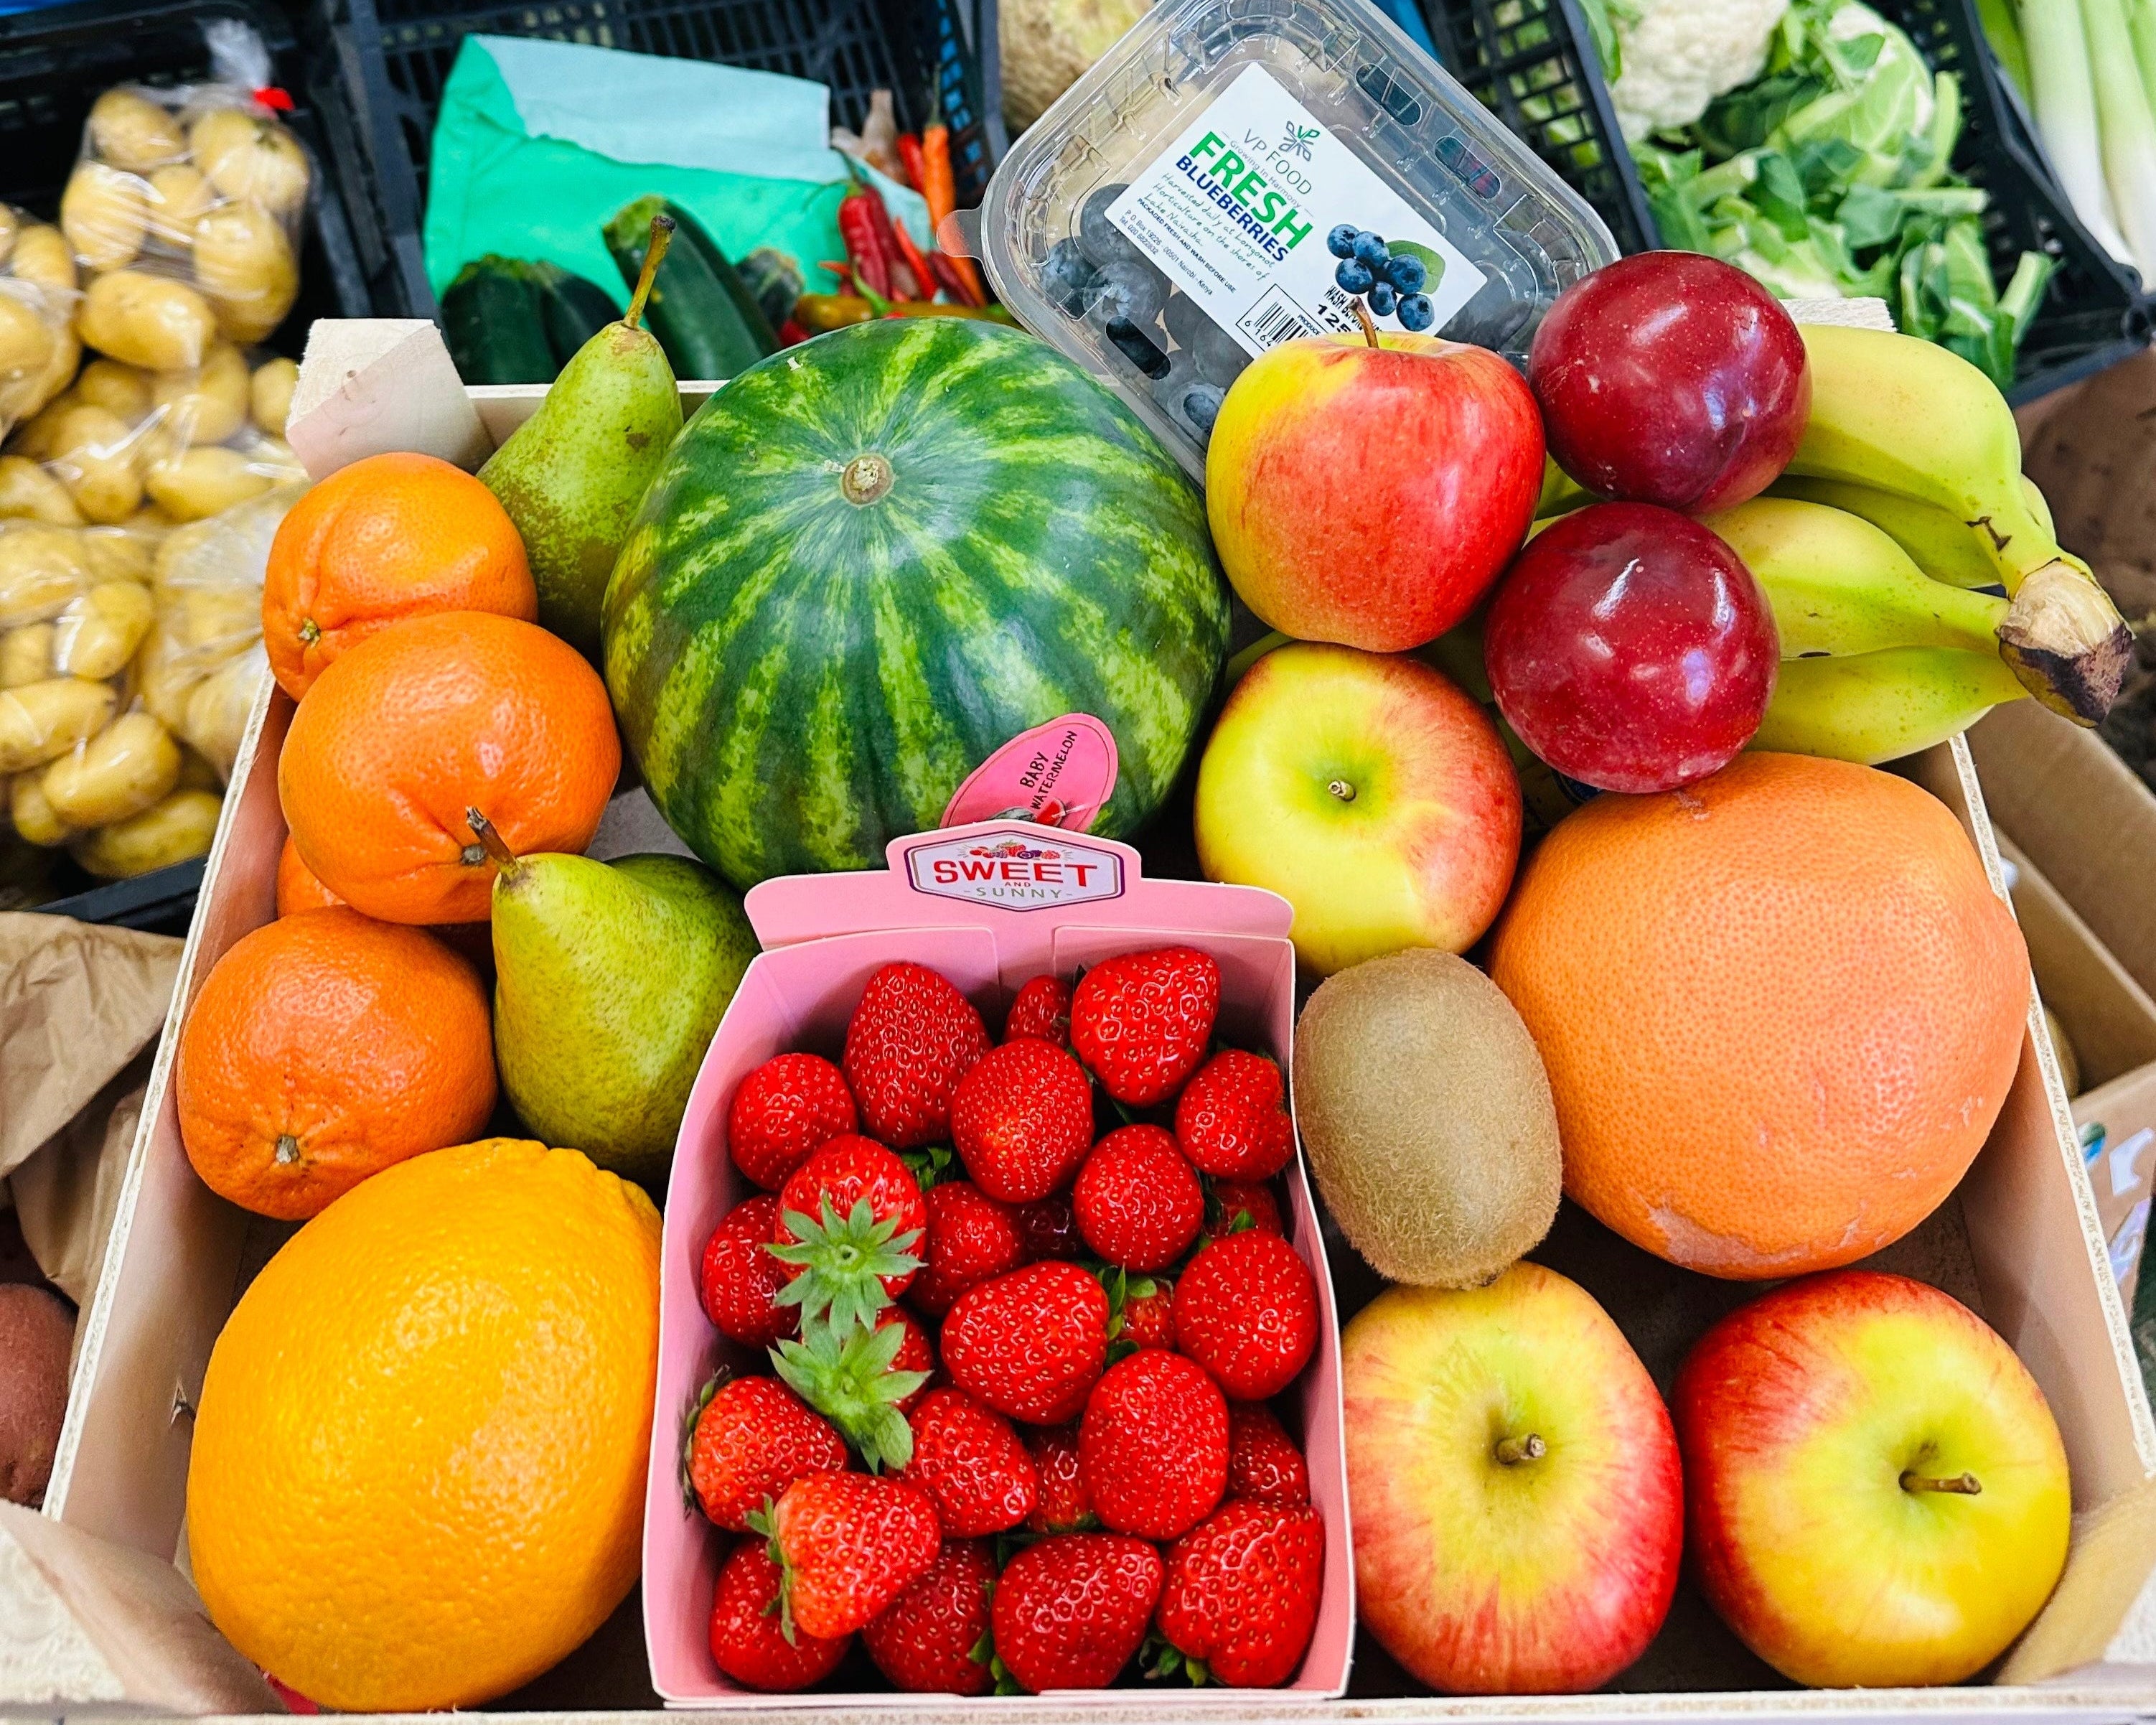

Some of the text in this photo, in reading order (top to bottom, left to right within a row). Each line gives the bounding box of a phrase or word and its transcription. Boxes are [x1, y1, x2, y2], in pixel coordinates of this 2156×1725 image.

[1189, 131, 1313, 250] FRESH
[1230, 140, 1260, 171] Growing
[1268, 177, 1302, 208] Harmony
[1244, 128, 1312, 195] VP FOOD
[1144, 192, 1166, 214] Lake
[1153, 182, 1270, 281] Horticulture on the shores of
[1161, 172, 1275, 268] Harvested daily at Longonot
[1176, 155, 1288, 261] BLUEBERRIES
[1136, 220, 1146, 231] Box
[1178, 260, 1196, 279] Nairobi
[1197, 279, 1213, 295] Kenya
[1137, 197, 1237, 294] PACKAGED FRESH AND WASH BEFORE USE
[1297, 314, 1321, 336] PRODUCE
[1324, 284, 1349, 309] WASH
[1020, 752, 1049, 788] BABY
[1030, 730, 1077, 810] WATERMELON
[933, 860, 1097, 887] SWEET
[975, 887, 1062, 899] SUNNY
